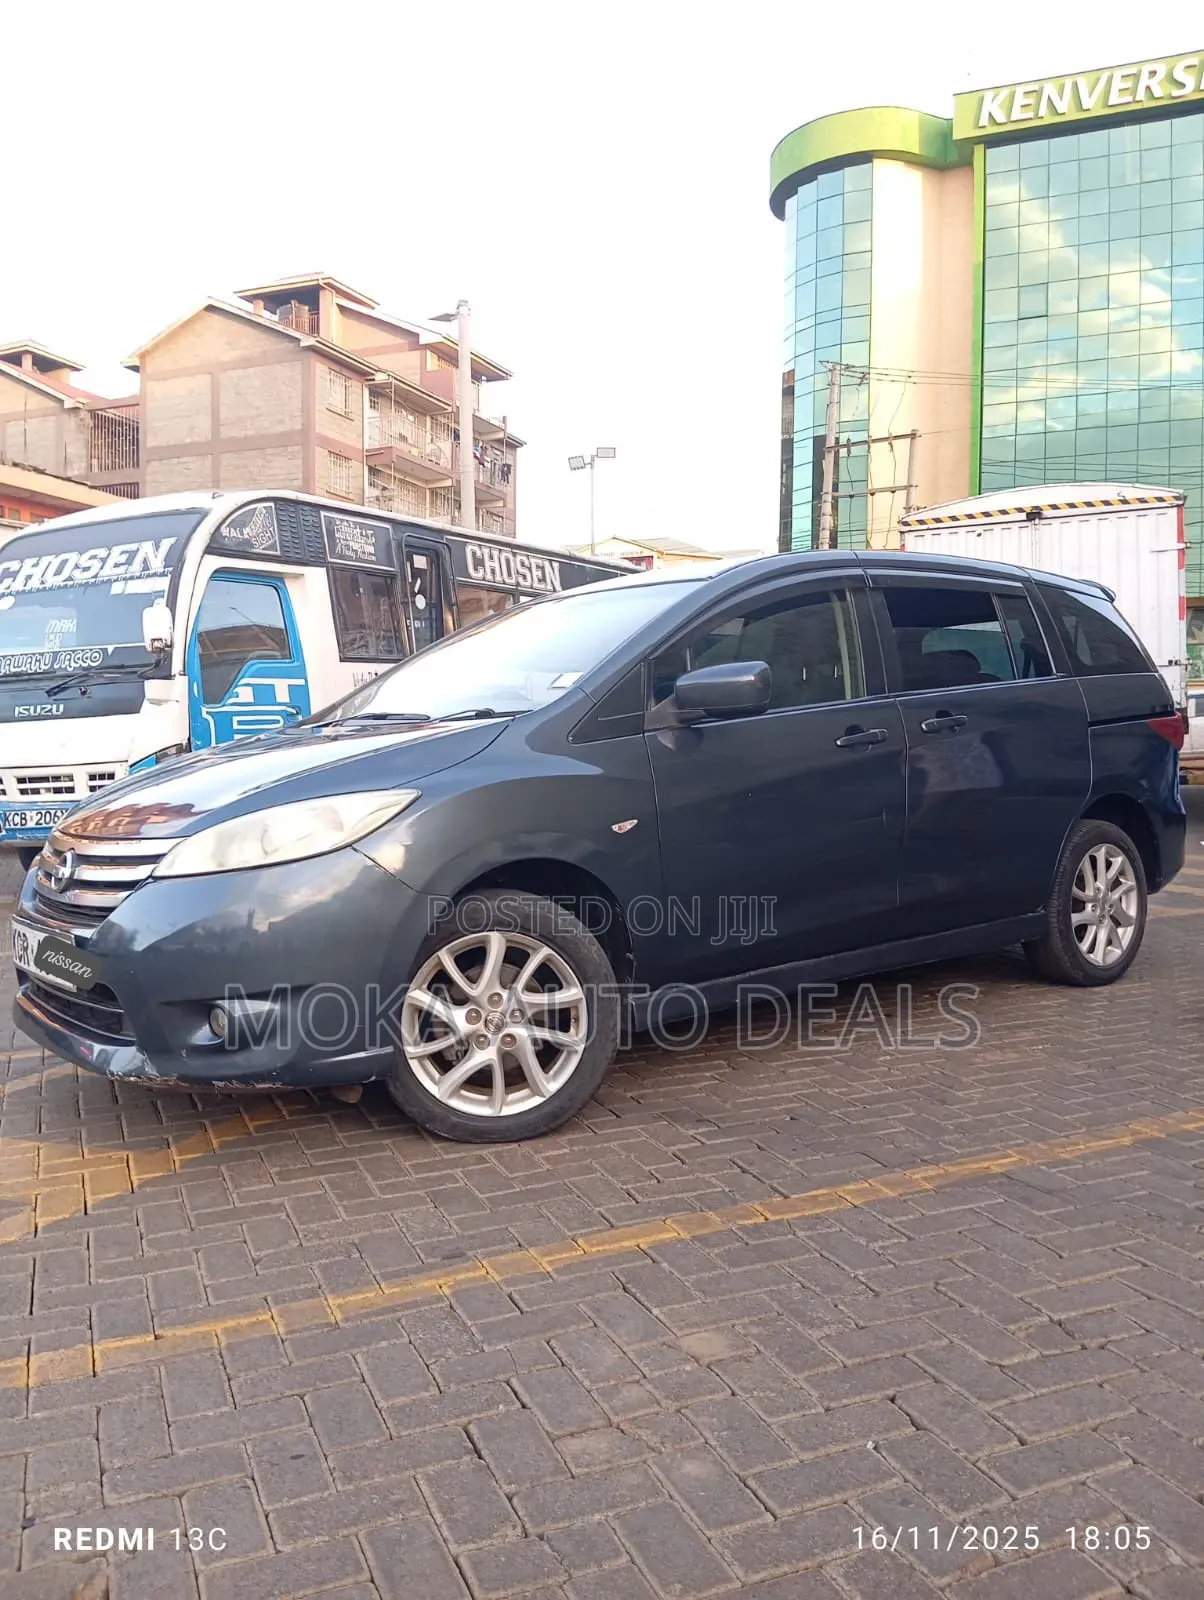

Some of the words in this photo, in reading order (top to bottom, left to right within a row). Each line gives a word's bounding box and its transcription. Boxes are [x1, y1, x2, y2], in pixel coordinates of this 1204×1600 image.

[977, 57, 1204, 128] KENVERS
[0, 537, 178, 592] CHOSEN
[465, 543, 563, 592] CHOSEN
[53, 648, 103, 671] SACCO
[14, 703, 64, 718] ISUZU
[4, 811, 27, 827] KCB
